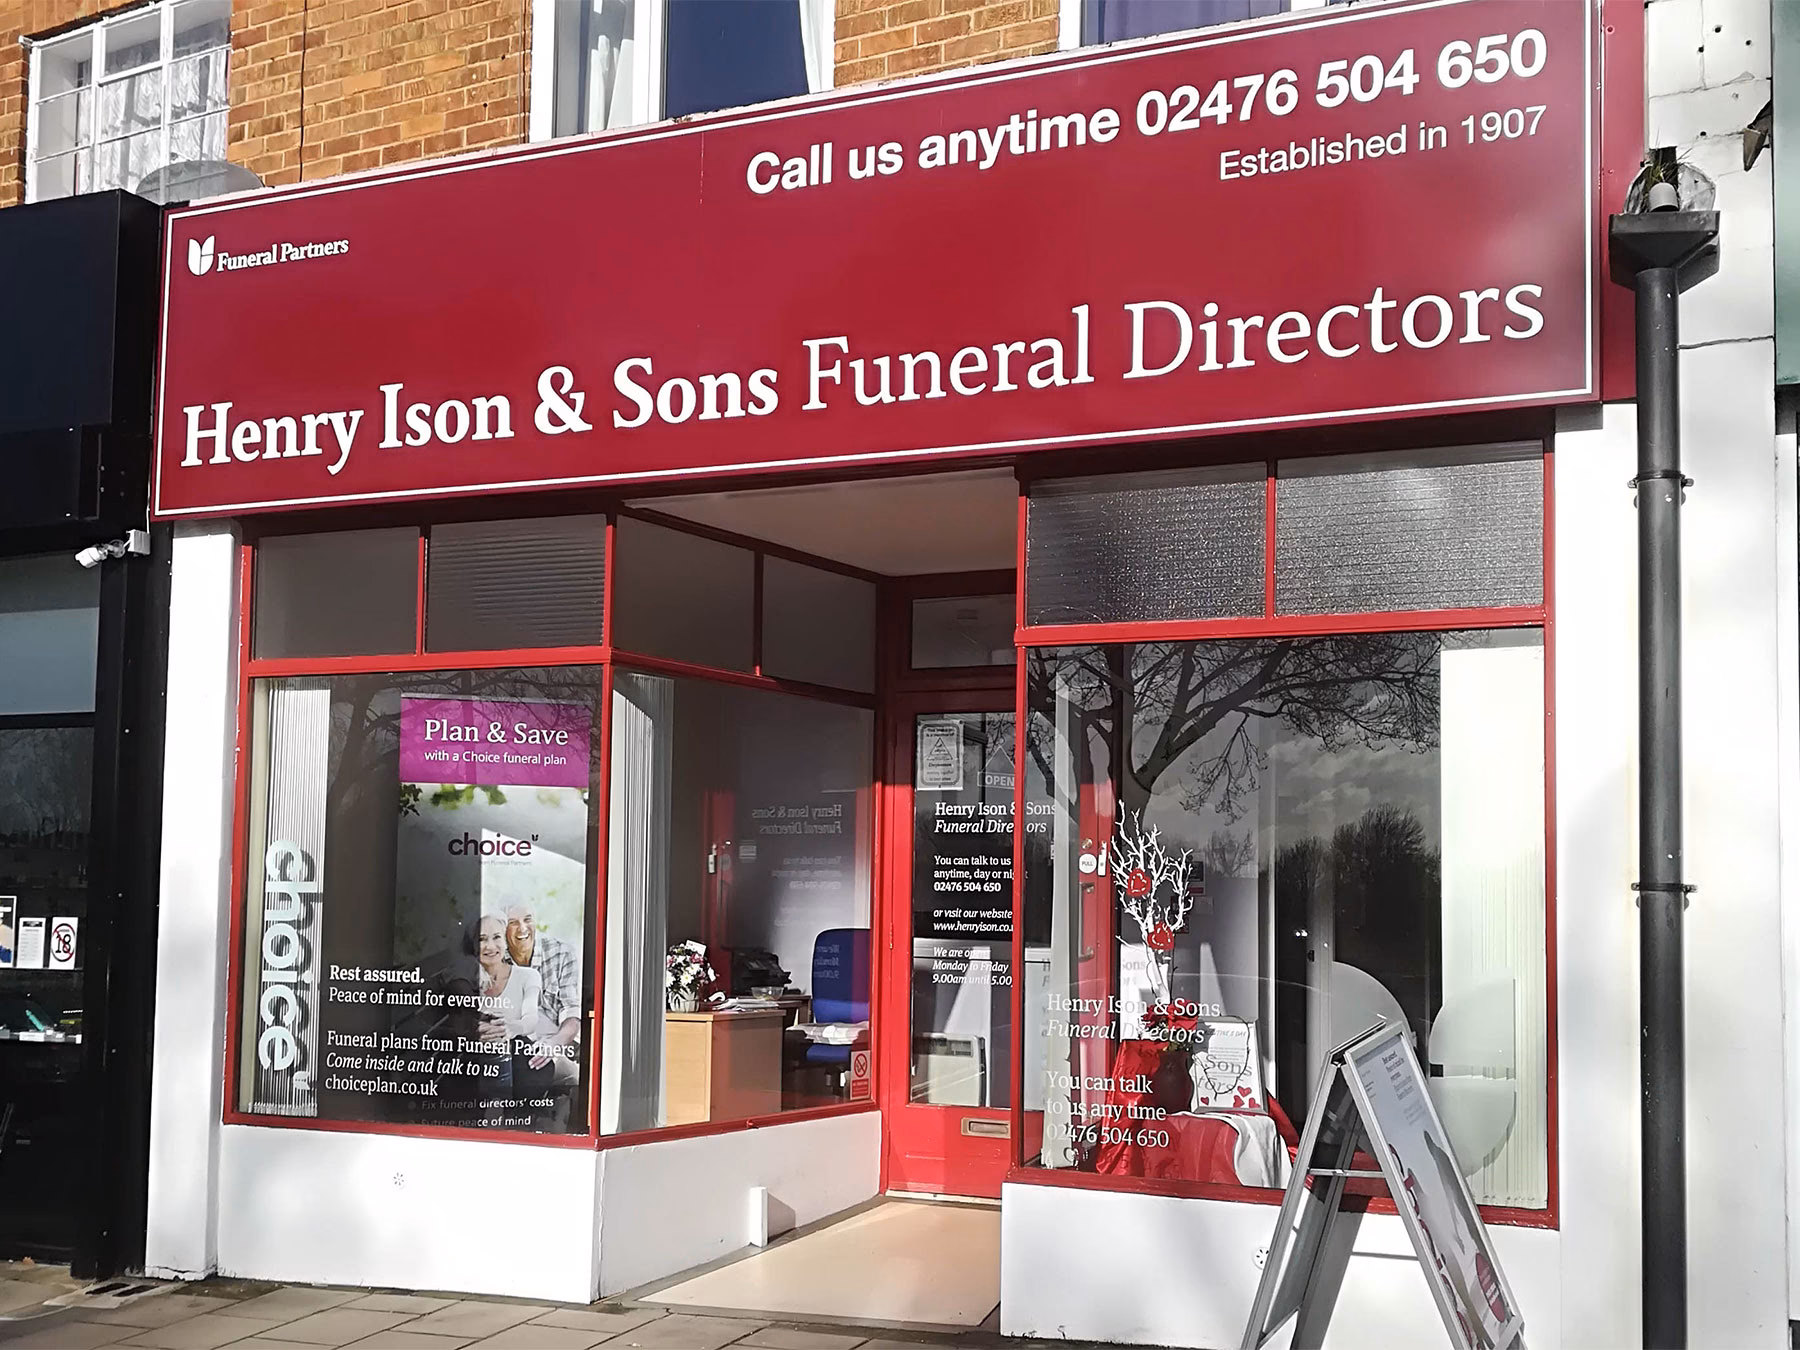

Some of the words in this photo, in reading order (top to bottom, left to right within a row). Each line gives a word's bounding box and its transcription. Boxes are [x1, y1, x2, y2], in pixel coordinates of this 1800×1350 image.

[745, 141, 832, 196] Call
[848, 137, 904, 178] us
[918, 101, 1119, 170] anytime
[1135, 68, 1298, 138] 02476
[1315, 48, 1419, 109] 504
[1436, 27, 1547, 84] 650
[1219, 122, 1407, 181] Established
[1418, 121, 1447, 152] in
[1461, 104, 1546, 144] 1907
[216, 244, 277, 273] Funeral
[279, 237, 350, 263] Partners
[180, 402, 364, 475] Henry
[378, 382, 514, 450] Ison
[533, 364, 593, 436] &
[612, 356, 779, 430] Sons
[801, 304, 1095, 411] Funeral
[1122, 279, 1544, 381] Directors
[424, 719, 479, 742] Plan
[486, 721, 507, 743] &
[513, 722, 569, 745] Save
[424, 750, 449, 761] with
[452, 753, 459, 761] a
[462, 751, 500, 763] Choice
[503, 752, 541, 765] funeral
[543, 754, 567, 767] plan
[985, 775, 1015, 787] OPEN
[935, 802, 976, 818] Henry
[978, 802, 1007, 816] Ison
[934, 819, 984, 833] Funeral
[986, 819, 1047, 833] Direors
[448, 832, 532, 857] choice
[934, 855, 951, 865] You
[953, 857, 969, 865] can
[971, 855, 988, 866] talk
[990, 856, 999, 865] to
[1000, 857, 1011, 866] us
[933, 868, 972, 880] anytime,
[974, 869, 990, 881] day
[992, 871, 1002, 879] or
[933, 882, 962, 892] 02476
[963, 882, 981, 892] 504
[983, 882, 1001, 892] 650
[933, 909, 943, 918] or
[944, 908, 962, 918] visit
[963, 910, 978, 918] our
[980, 908, 1013, 919] website
[933, 920, 1014, 933] www.henryison.co.
[55, 934, 71, 953] 18
[933, 947, 947, 957] We
[948, 950, 962, 958] are
[258, 839, 318, 1071] choice
[330, 965, 361, 981] Rest
[363, 966, 425, 984] assured.
[932, 960, 968, 973] Monday
[969, 961, 979, 970] to
[981, 961, 1009, 974] Friday
[932, 974, 966, 984] 9.00am
[968, 975, 990, 985] until
[329, 987, 366, 1004] Peace
[369, 988, 384, 1005] of
[386, 989, 422, 1006] mind
[425, 989, 445, 1007] for
[447, 993, 514, 1013] everyone.
[1047, 994, 1103, 1017] Henry
[1108, 995, 1148, 1014] Ison
[1153, 998, 1170, 1015] &
[1173, 998, 1221, 1017] Sons
[1046, 1020, 1117, 1040] Funeral
[327, 1030, 378, 1049] Funeral
[381, 1033, 418, 1052] plans
[421, 1035, 454, 1052] from
[457, 1036, 511, 1056] Funeral
[514, 1039, 575, 1058] Partners
[326, 1052, 362, 1069] Come
[365, 1053, 405, 1071] inside
[408, 1055, 433, 1073] and
[436, 1057, 463, 1075] talk
[466, 1059, 480, 1076] to
[483, 1063, 499, 1078] us
[325, 1073, 438, 1096] choiceplan.co.uk
[1046, 1071, 1080, 1090] You
[1084, 1076, 1115, 1092] can
[1119, 1074, 1153, 1094] talk
[421, 1100, 437, 1110] Fix
[439, 1099, 477, 1109] funeral
[529, 1098, 554, 1108] costs
[1046, 1098, 1063, 1115] to
[1068, 1101, 1087, 1116] us
[1090, 1103, 1124, 1123] any
[1126, 1100, 1167, 1121] time
[457, 1118, 488, 1128] peace
[490, 1115, 503, 1127] of
[505, 1115, 531, 1127] mind
[1046, 1124, 1098, 1143] 02476
[1100, 1127, 1133, 1146] 504
[1136, 1128, 1169, 1148] 650
